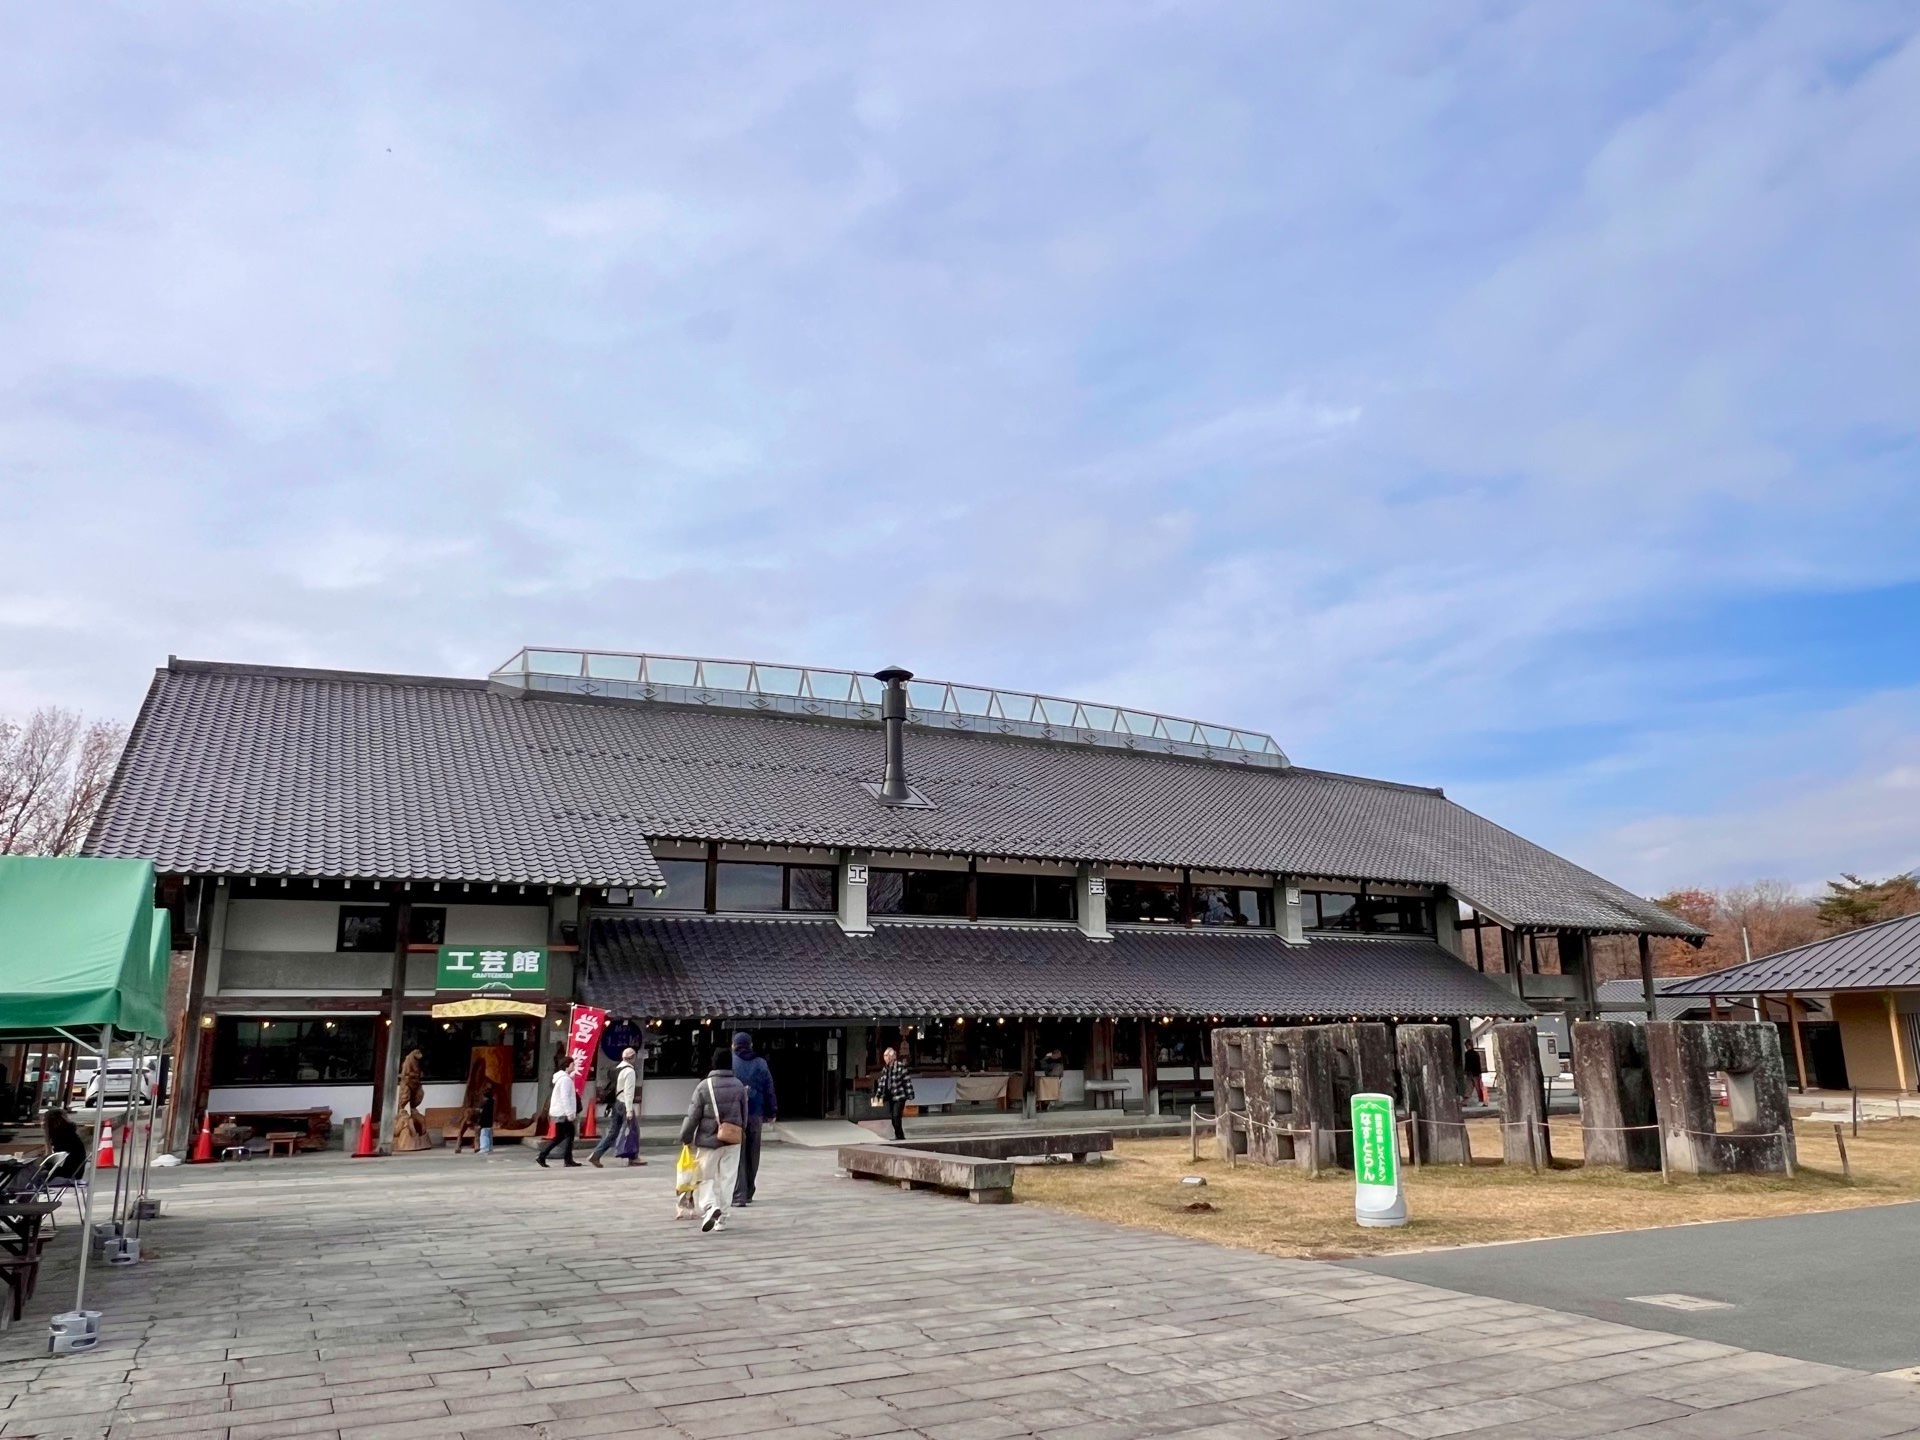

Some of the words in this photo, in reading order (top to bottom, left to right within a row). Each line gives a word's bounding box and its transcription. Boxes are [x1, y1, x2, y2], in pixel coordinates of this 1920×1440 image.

[446, 951, 540, 973] 工芸館
[1360, 1112, 1375, 1181] なすとらん
